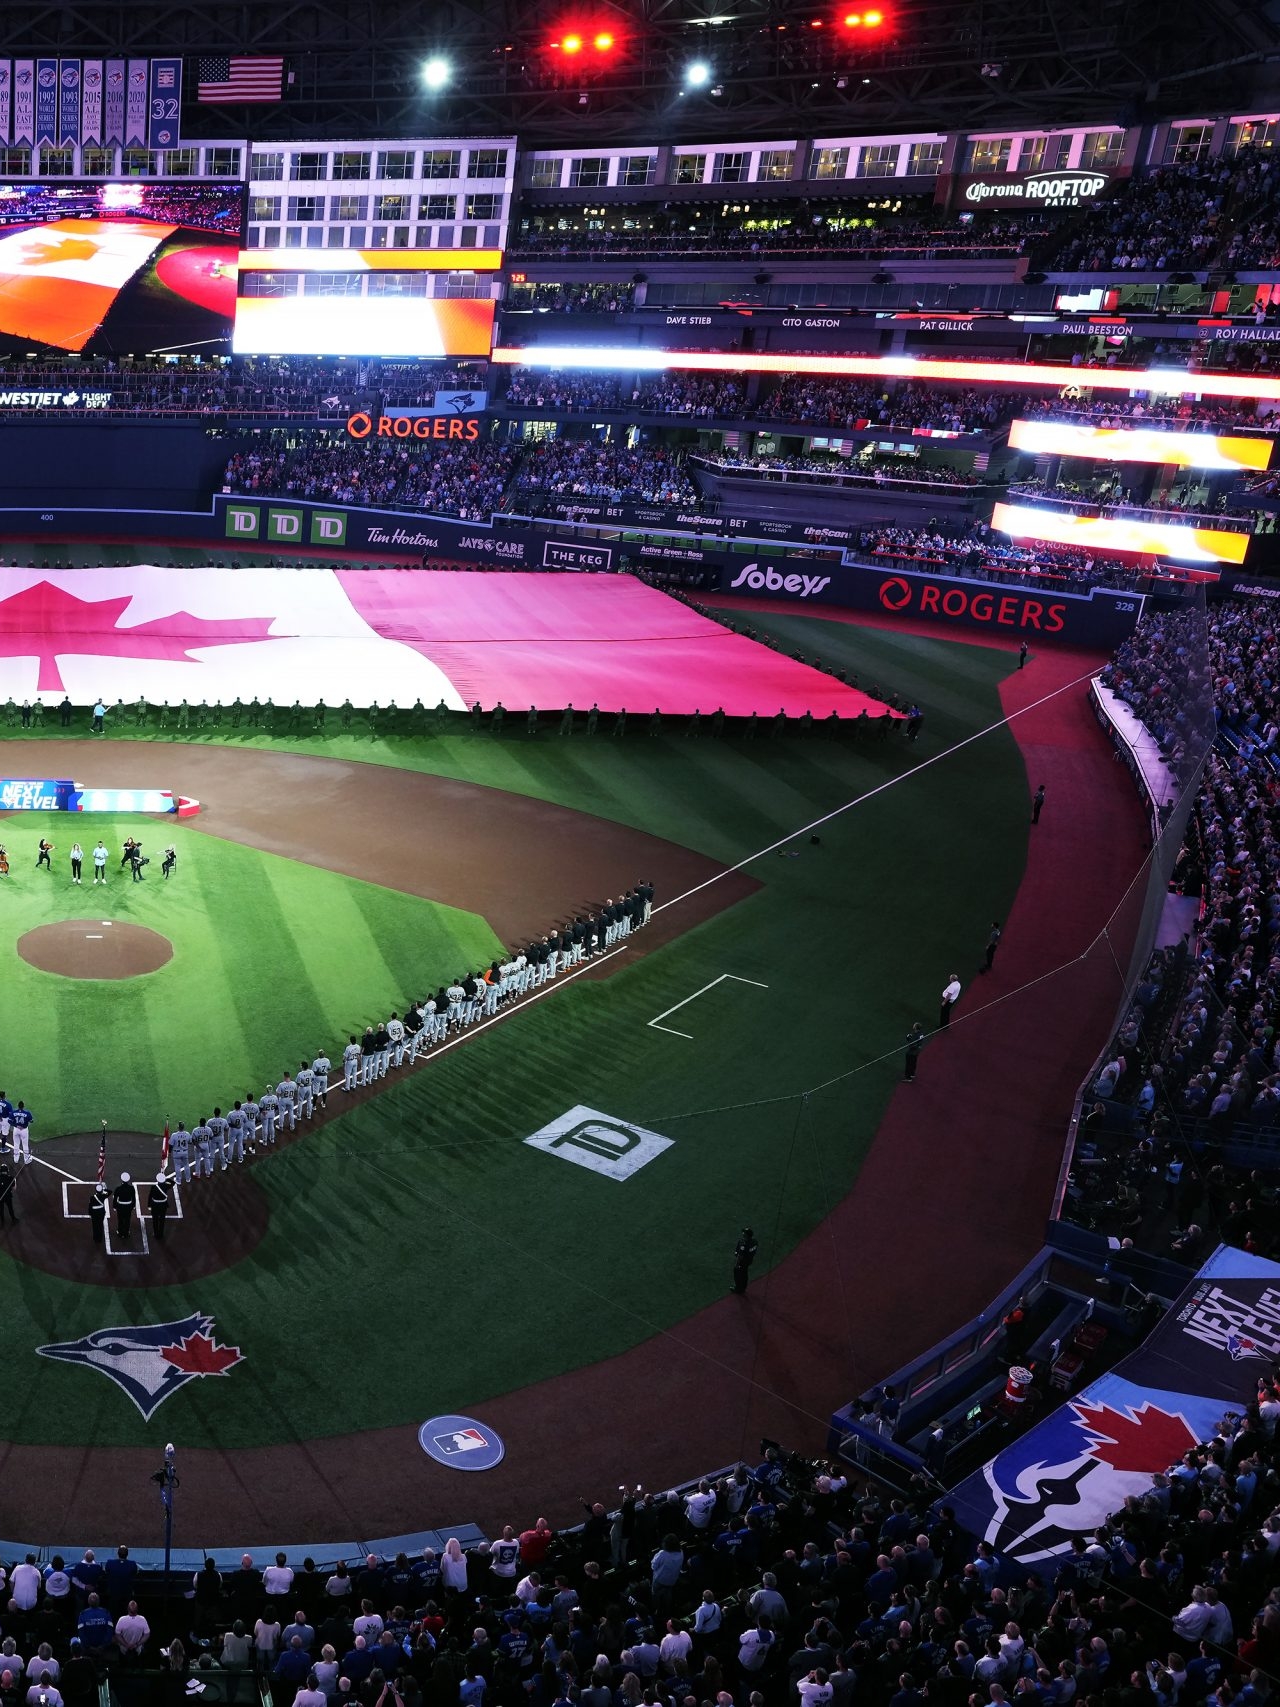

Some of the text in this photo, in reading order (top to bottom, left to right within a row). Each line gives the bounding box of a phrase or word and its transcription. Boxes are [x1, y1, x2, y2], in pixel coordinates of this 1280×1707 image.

[152, 99, 178, 119] 32
[966, 178, 1105, 202] Corona ROOFTOP
[377, 416, 480, 441] ROGERS
[229, 511, 256, 532] TD
[272, 514, 299, 536] TD
[317, 517, 343, 538] TD
[367, 527, 438, 548] Tim Hortons
[458, 536, 525, 555] JAYS CARE
[730, 563, 831, 597] Sobeys
[920, 586, 1066, 632] ROGERS
[2, 784, 44, 797] NEXT
[16, 796, 59, 809] LEVEL
[548, 1119, 641, 1161] TD
[1176, 1302, 1197, 1322] TORONTO
[1183, 1287, 1254, 1351] NEXT
